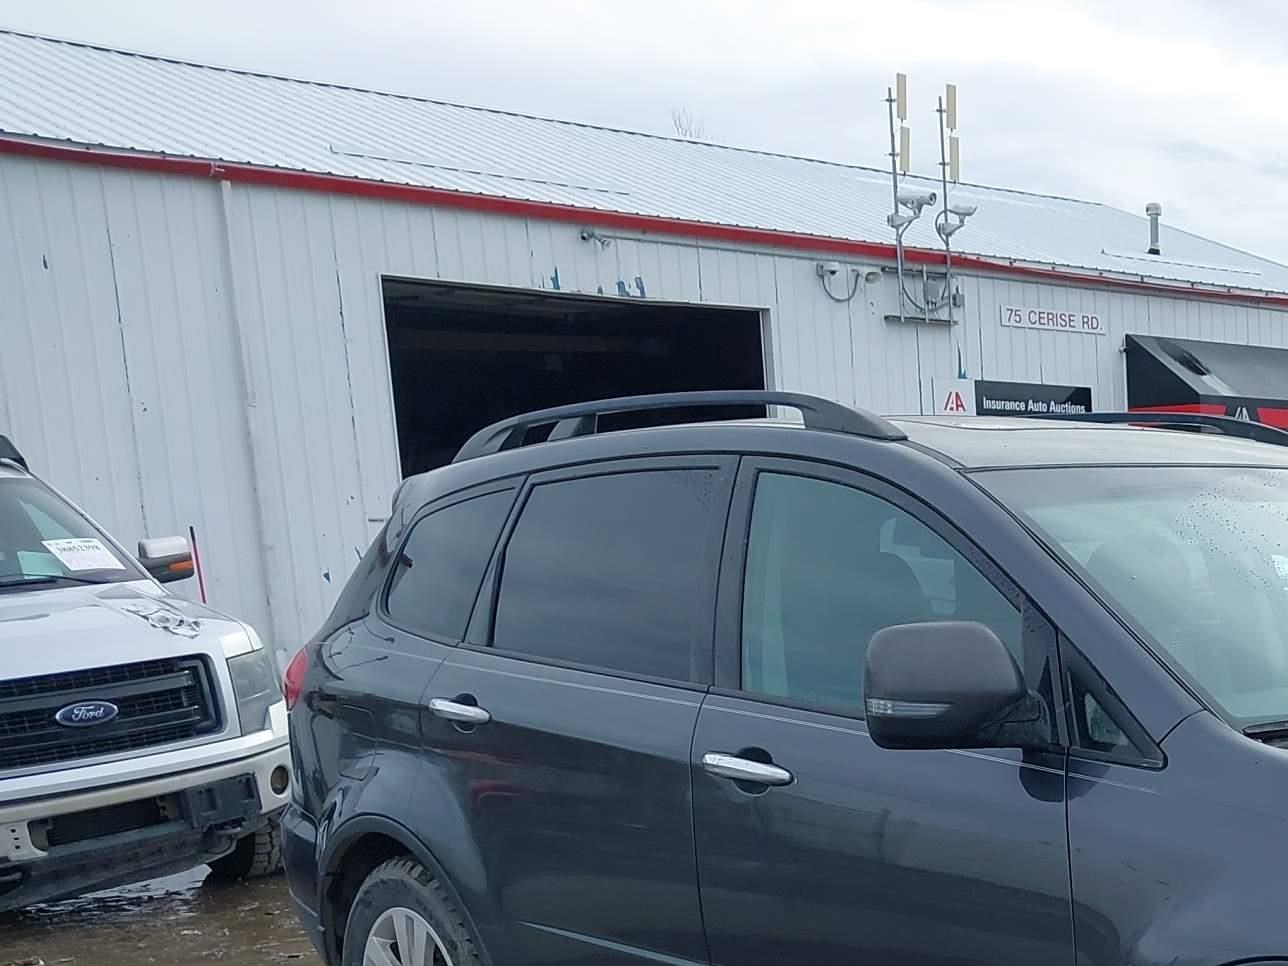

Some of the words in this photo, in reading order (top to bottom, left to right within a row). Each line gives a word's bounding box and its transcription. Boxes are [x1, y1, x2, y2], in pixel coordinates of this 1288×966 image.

[1006, 308, 1022, 323] 75
[1028, 310, 1076, 328] CERISE
[1081, 315, 1103, 330] RD.
[983, 396, 1025, 412] Insurance
[1028, 399, 1047, 413] Auto
[1049, 400, 1086, 414] Auctions
[71, 705, 105, 721] Ford
